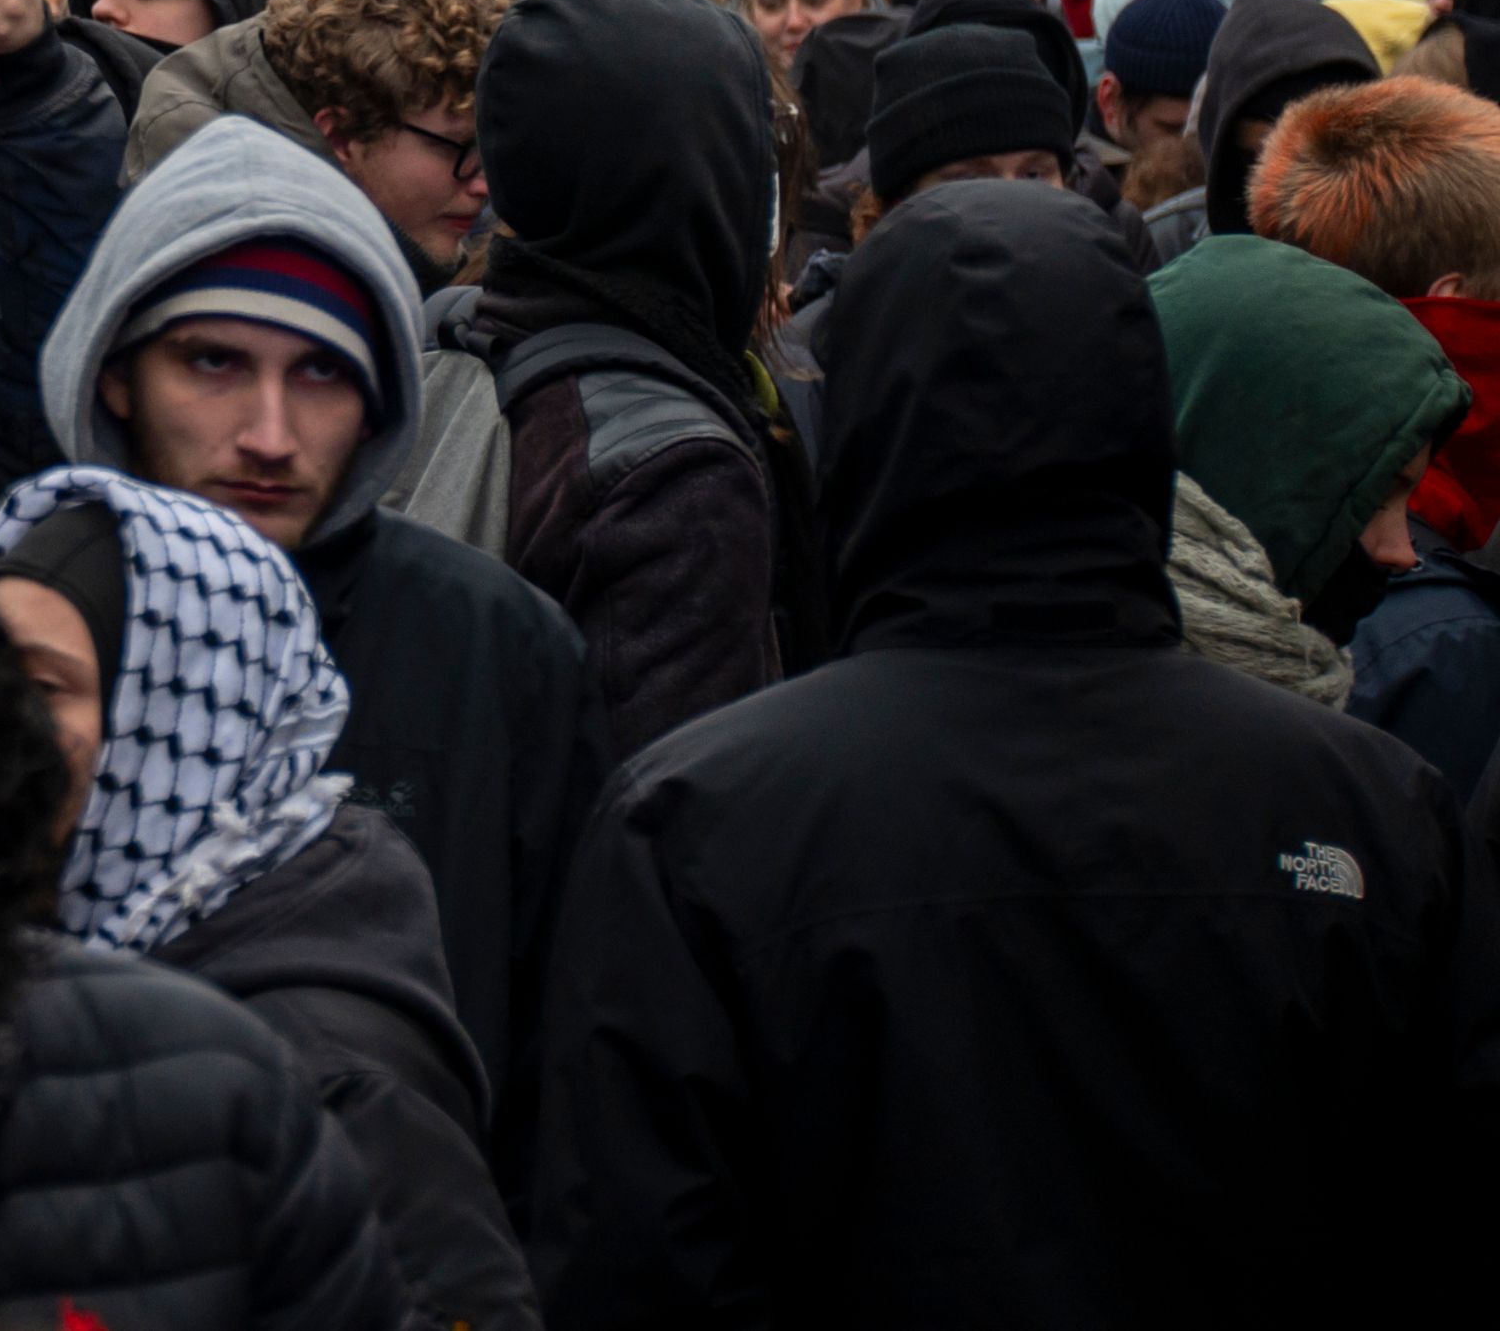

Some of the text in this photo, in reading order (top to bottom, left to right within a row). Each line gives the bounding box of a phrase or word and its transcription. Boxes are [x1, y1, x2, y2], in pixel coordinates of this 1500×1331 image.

[1304, 841, 1336, 861] THE
[1279, 853, 1339, 878] NORTH
[1296, 873, 1342, 893] FACE
